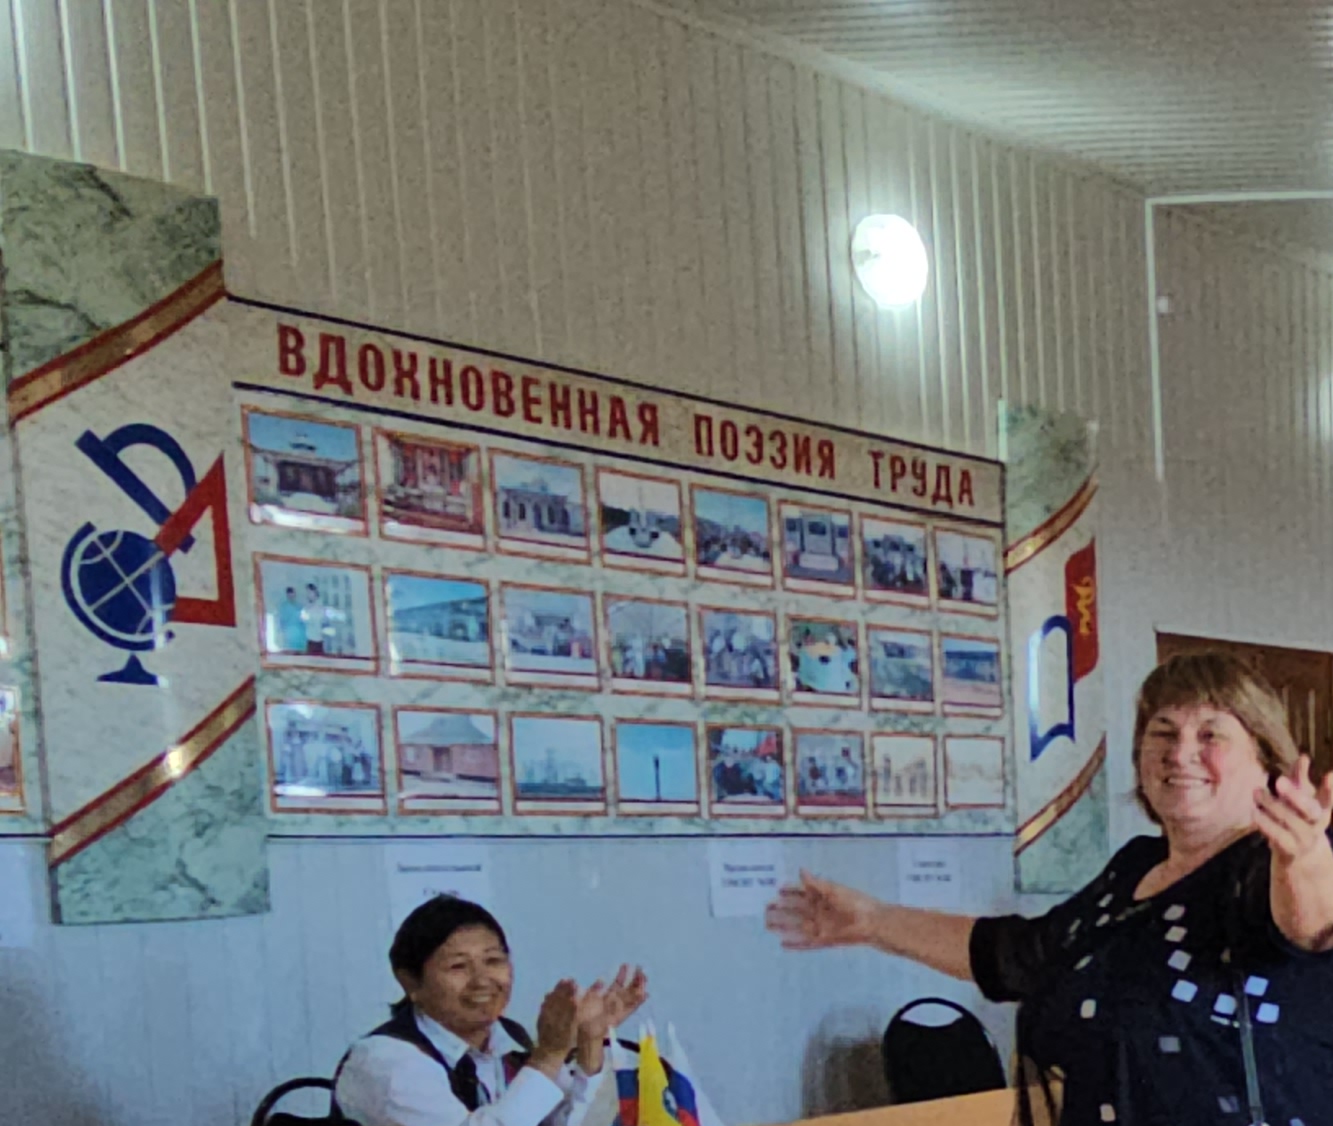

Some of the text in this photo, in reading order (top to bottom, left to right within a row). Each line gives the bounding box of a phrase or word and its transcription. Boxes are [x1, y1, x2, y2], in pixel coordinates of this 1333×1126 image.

[276, 322, 975, 508] ВДОХНОВЕННАЯ ПОЭЗИЯ ТРУДА
